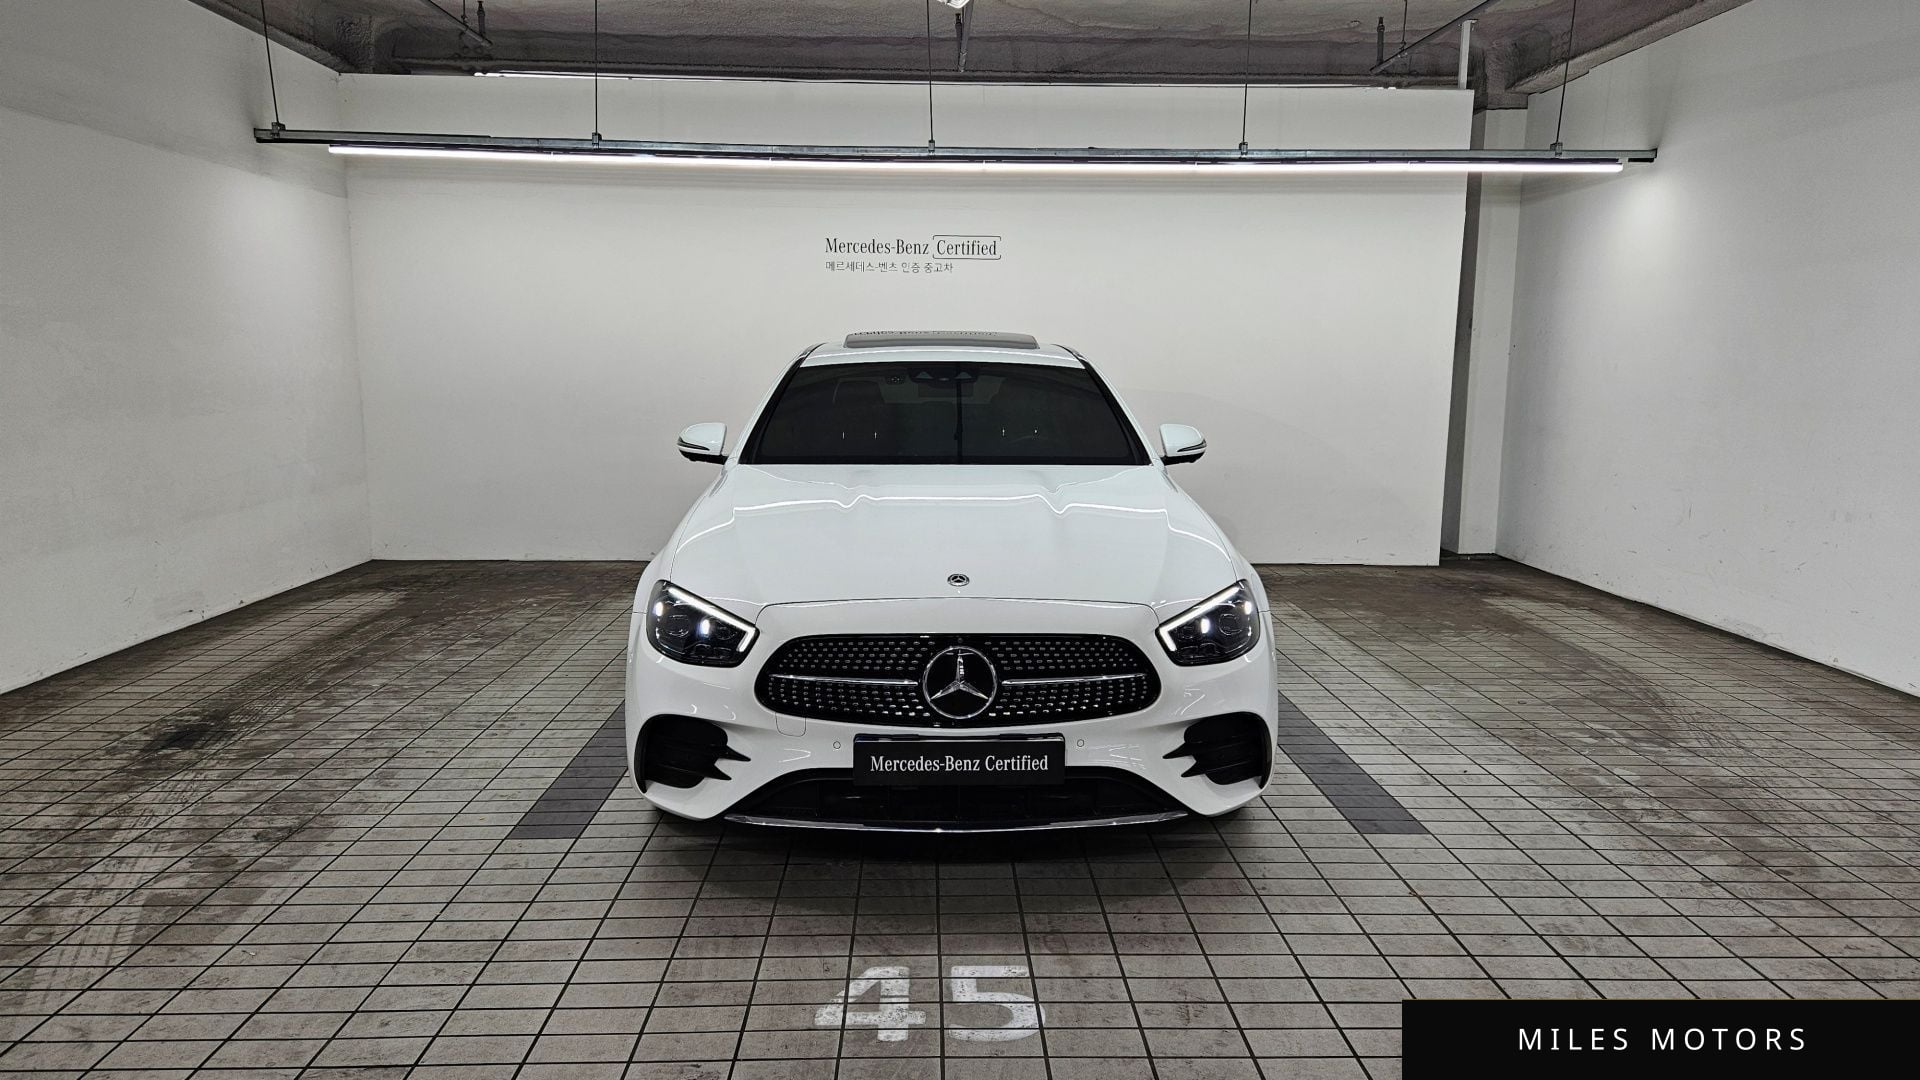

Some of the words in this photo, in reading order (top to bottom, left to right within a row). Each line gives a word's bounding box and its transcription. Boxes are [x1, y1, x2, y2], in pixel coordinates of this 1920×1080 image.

[825, 237, 929, 255] Mercedes-Benz
[936, 239, 997, 256] Certified
[825, 261, 898, 273] 메르세데스-벤츠
[901, 262, 921, 274] 인증
[924, 262, 953, 274] 중고차
[870, 755, 980, 772] Mercedes-Benz
[984, 754, 1049, 772] Certified
[814, 965, 1046, 1042] 45
